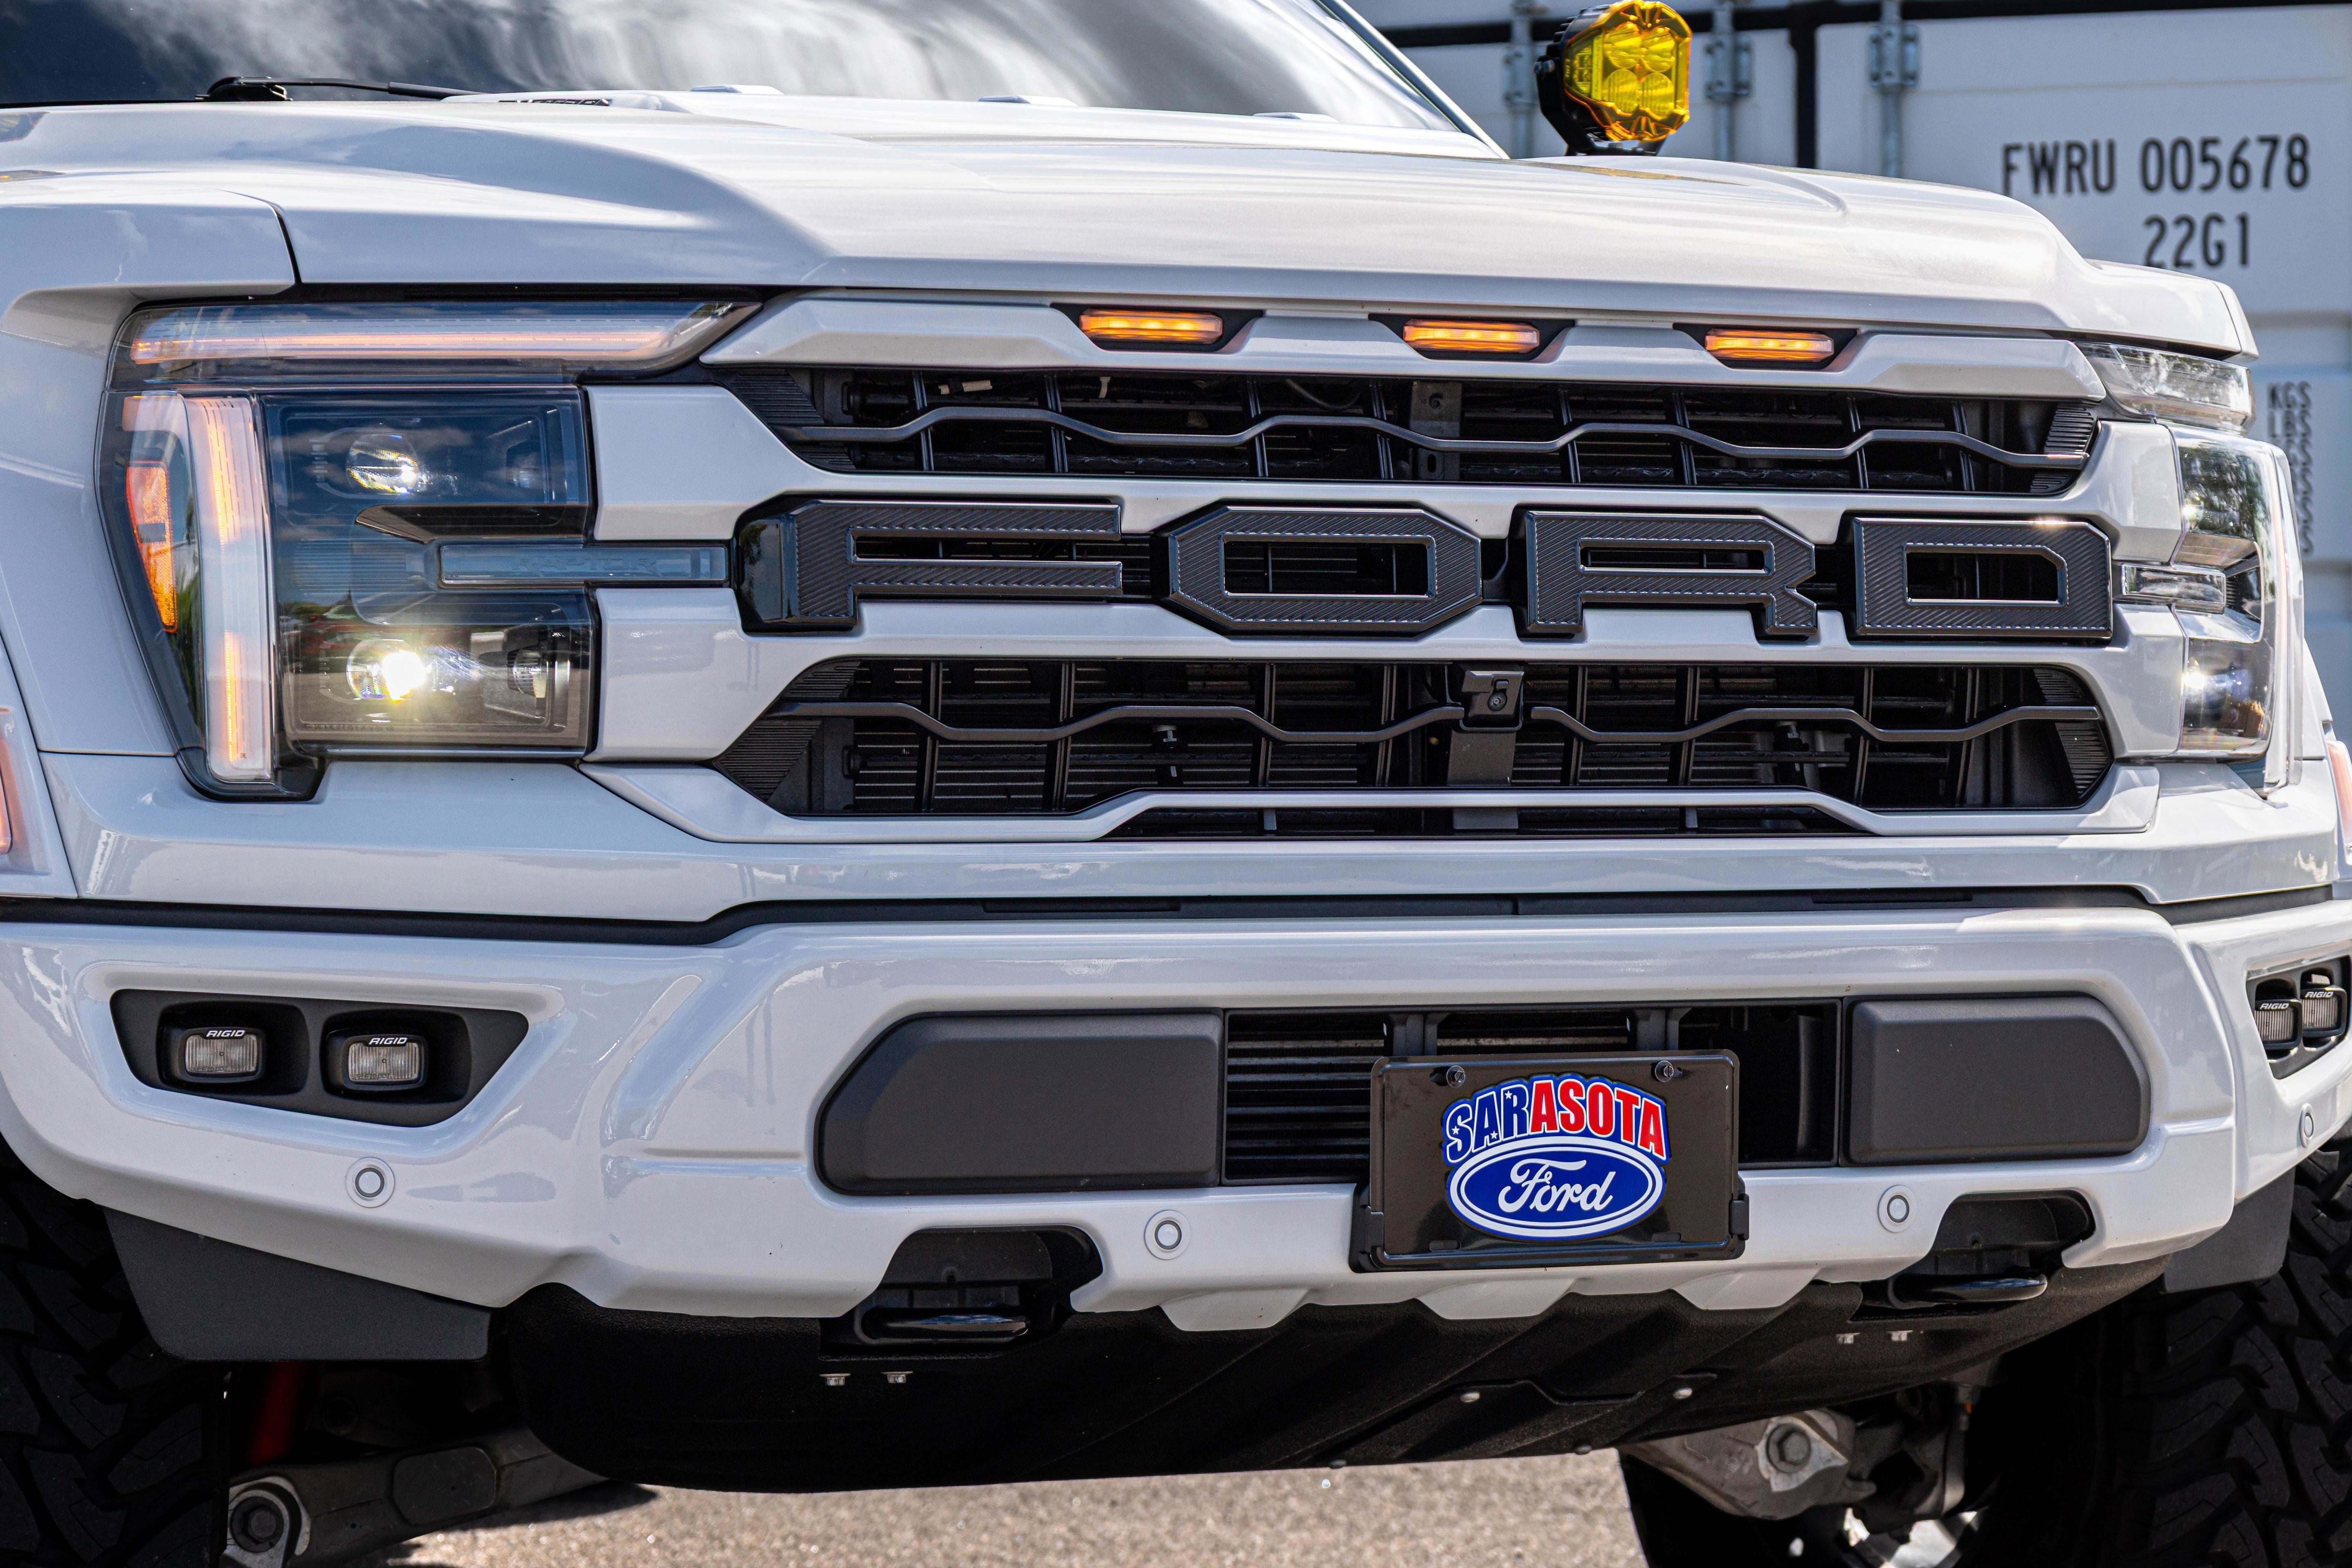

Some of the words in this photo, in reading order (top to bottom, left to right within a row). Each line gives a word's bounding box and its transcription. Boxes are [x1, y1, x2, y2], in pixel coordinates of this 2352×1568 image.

[2002, 139, 2116, 195] FWRU
[2140, 134, 2310, 192] 005678
[2144, 212, 2250, 268] 22G1
[2267, 381, 2311, 409] KGS
[2267, 410, 2312, 437] LBS
[786, 499, 2114, 639] FORD
[1446, 1079, 1666, 1163] SARASOTA
[1498, 1158, 1617, 1212] Ford
